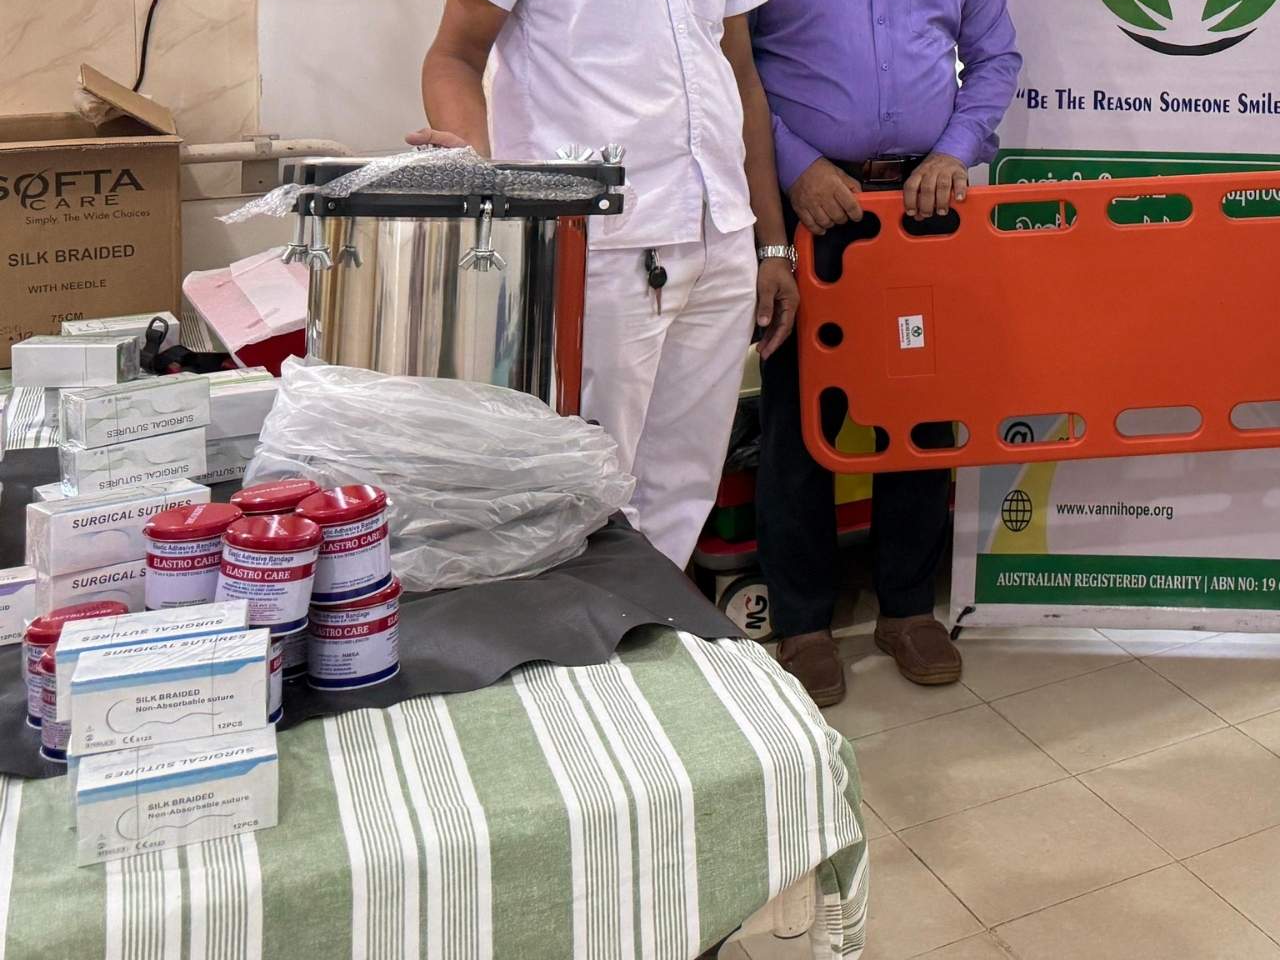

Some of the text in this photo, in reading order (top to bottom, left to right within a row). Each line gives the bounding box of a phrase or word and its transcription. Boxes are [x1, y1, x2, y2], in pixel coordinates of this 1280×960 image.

[29, 194, 120, 211] CARE
[64, 213, 80, 223] The
[84, 211, 110, 221] Wide
[113, 209, 151, 219] Choices
[8, 244, 135, 268] SILK BRAIDED
[27, 279, 107, 295] WITH NEEDLE
[51, 312, 84, 324] 75CM
[106, 414, 194, 439] SURGICAL SUTURES
[98, 464, 189, 490] SURGICAL SUTURES
[72, 510, 134, 529] SURGICAL
[1056, 502, 1174, 520] www.vannihope.org
[360, 531, 381, 545] CARE
[153, 557, 192, 569] ELASTRO
[194, 555, 220, 567] CARE
[72, 570, 137, 589] SURGICAL
[226, 565, 262, 580] ELASTRO
[264, 570, 291, 580] CARE
[997, 571, 1072, 588] AUSTRALIAN
[1074, 573, 1147, 589] REGISTERED
[1149, 574, 1202, 590] CHARITY
[1210, 576, 1235, 591] ABN
[1238, 576, 1259, 592] NO:
[1262, 577, 1276, 592] 19
[82, 618, 224, 642] SURGICAL SUTURES
[344, 625, 369, 636] CARE
[103, 633, 247, 657] SURGICAL SUTURES
[135, 694, 234, 713] Non-Absorbable suture
[136, 689, 200, 704] SILK BRAIDED
[217, 720, 243, 729] 12PCS
[104, 746, 255, 780] SURGICAL SUTURES
[147, 795, 250, 819] Non-Absorbable suture
[148, 792, 215, 811] SILK BRAIDED
[233, 820, 259, 830] 12PCS
